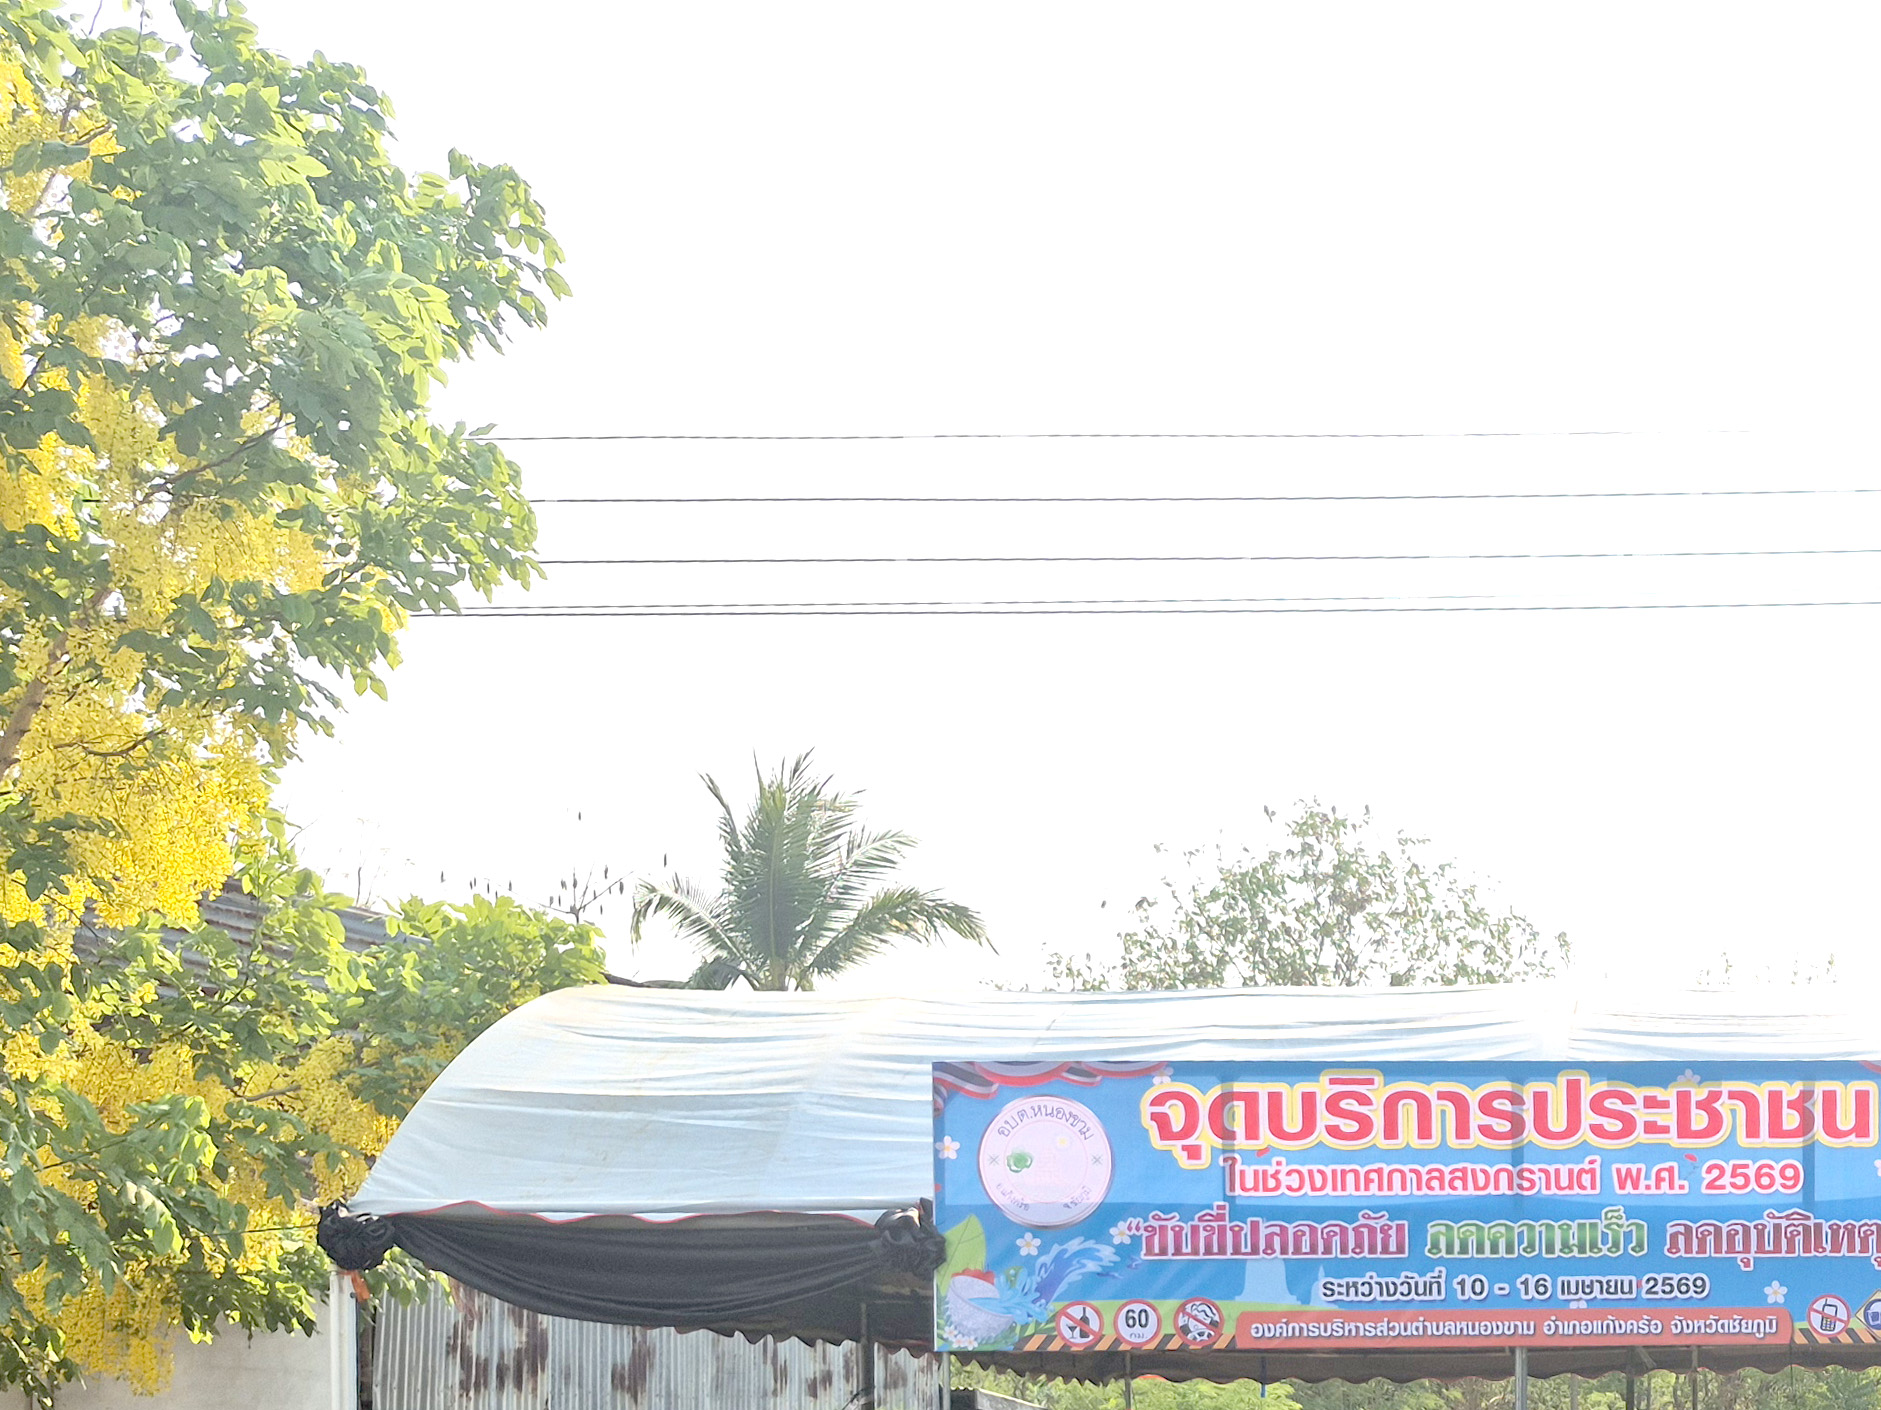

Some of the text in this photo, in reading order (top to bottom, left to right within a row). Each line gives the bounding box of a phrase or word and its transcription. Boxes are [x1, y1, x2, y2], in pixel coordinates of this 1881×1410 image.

[997, 1104, 1094, 1140] อบต.หนองขาม
[1148, 1076, 1870, 1160] จุดบริการประชาชน
[1223, 1156, 1801, 1193] ในช่วงเทศกาลสงกรานต์ พ.ศ. 2569
[1127, 1204, 1406, 1257] “ขับขี่ปลอดภัย
[1427, 1208, 1646, 1256] ลดความเร็ว
[1321, 1269, 1443, 1298] ระหว่างวันที่
[1455, 1278, 1486, 1297] 10
[1520, 1277, 1550, 1297] 16
[1560, 1279, 1633, 1297] เมษายน
[1645, 1276, 1707, 1296] 2569
[1125, 1308, 1149, 1329] 60
[1250, 1315, 1778, 1338] องค์การบริหารส่วนตำบลหนองขาม อำเภอแก้งคร้อ จังหวัดชัยภูมิ
